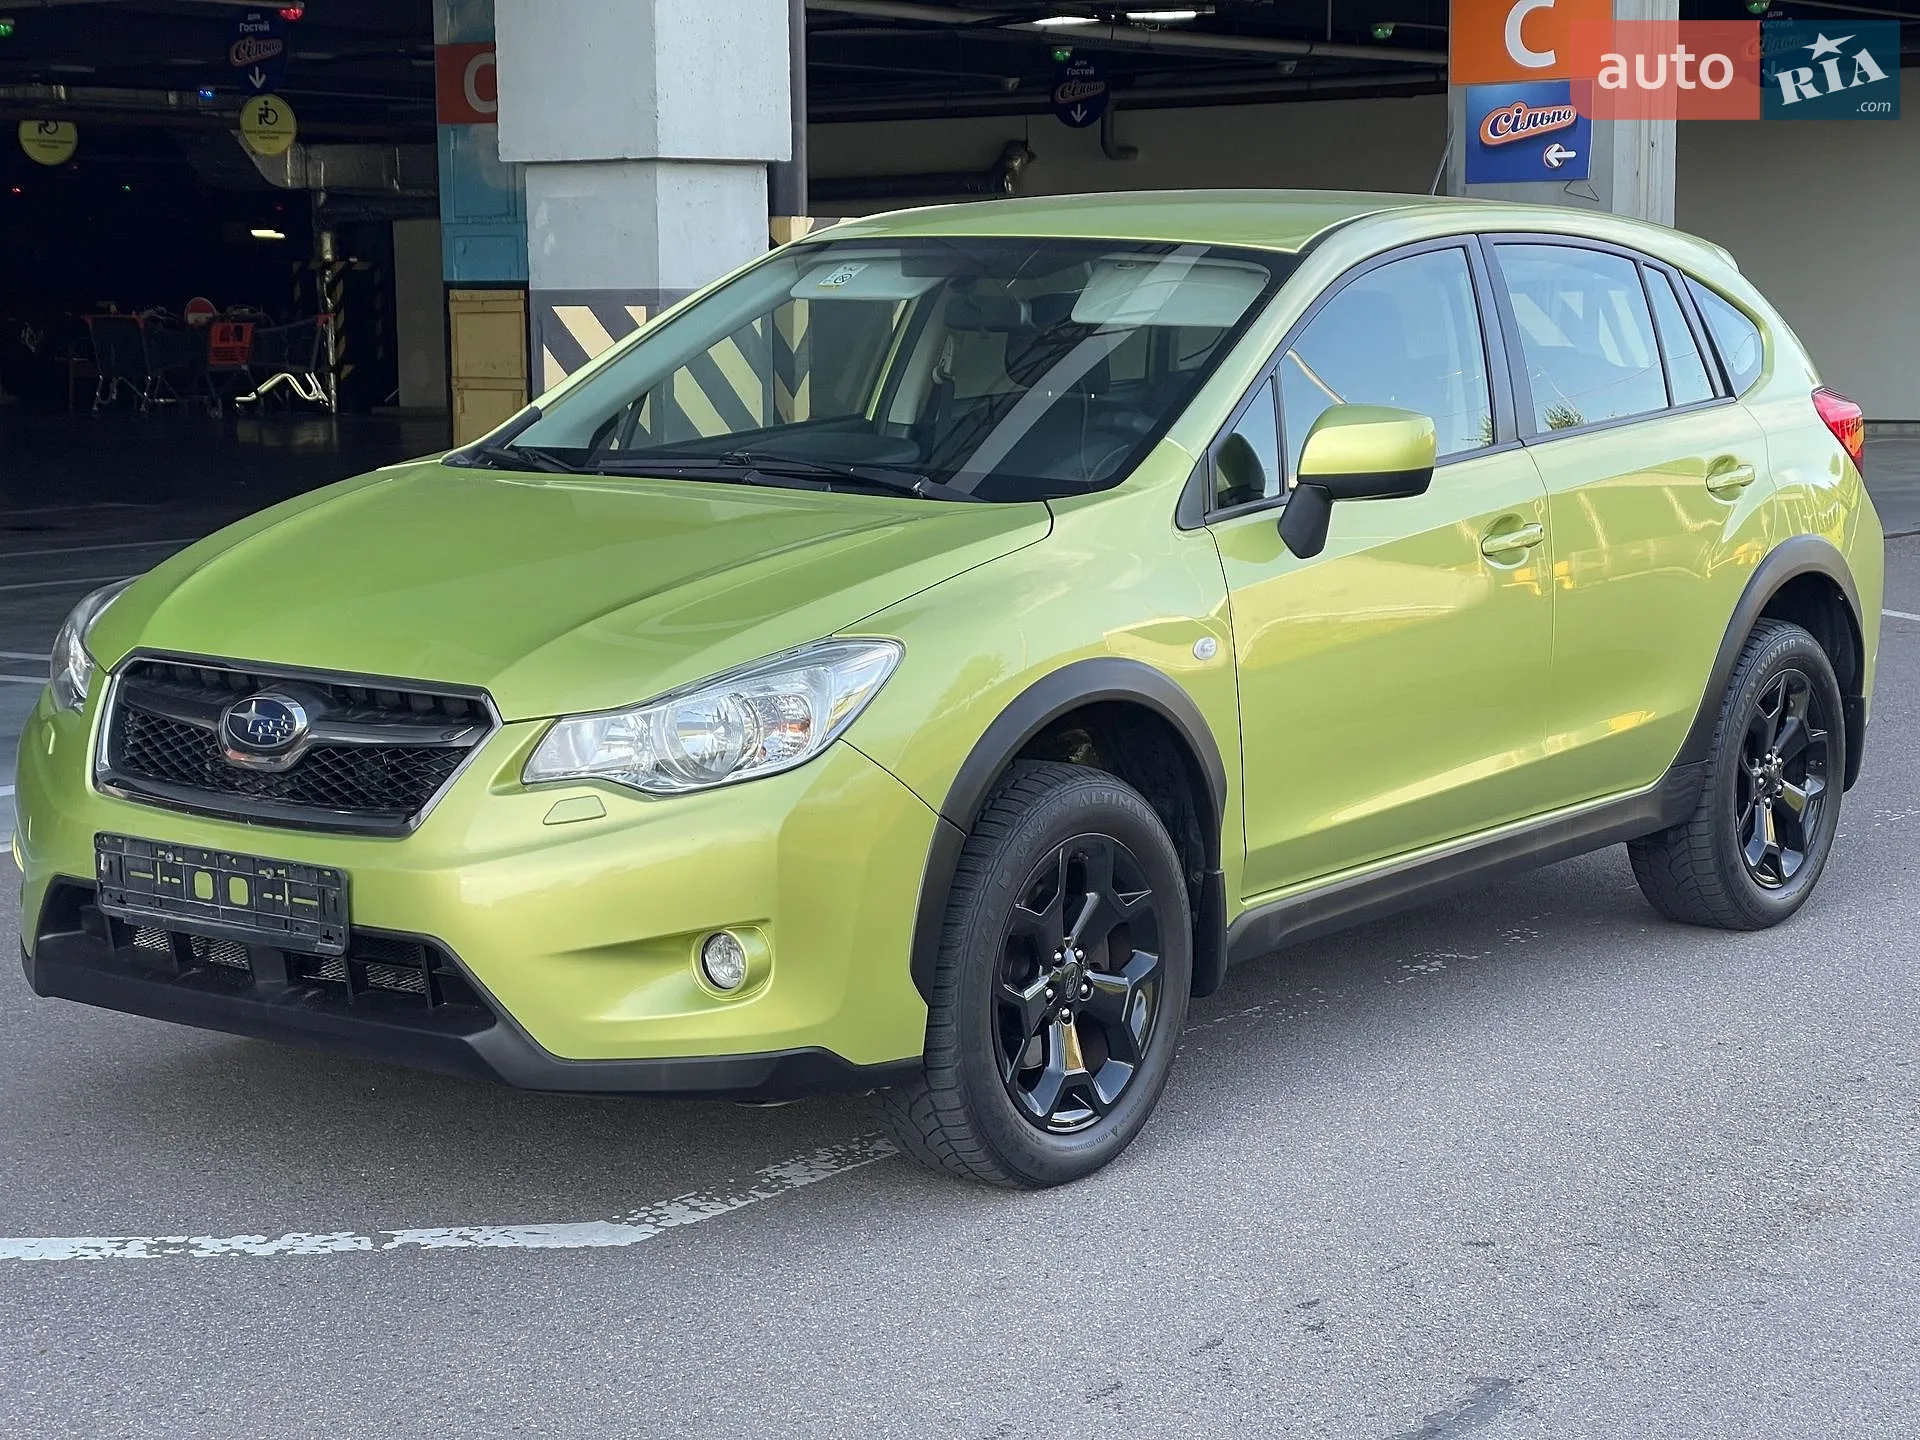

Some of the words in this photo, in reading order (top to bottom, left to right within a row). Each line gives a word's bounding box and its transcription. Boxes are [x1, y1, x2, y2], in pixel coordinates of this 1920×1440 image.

[239, 20, 270, 33] Гостей
[1066, 66, 1095, 77] Гостей
[1487, 107, 1574, 139] Сільпо
[1757, 638, 1796, 676] WINTER
